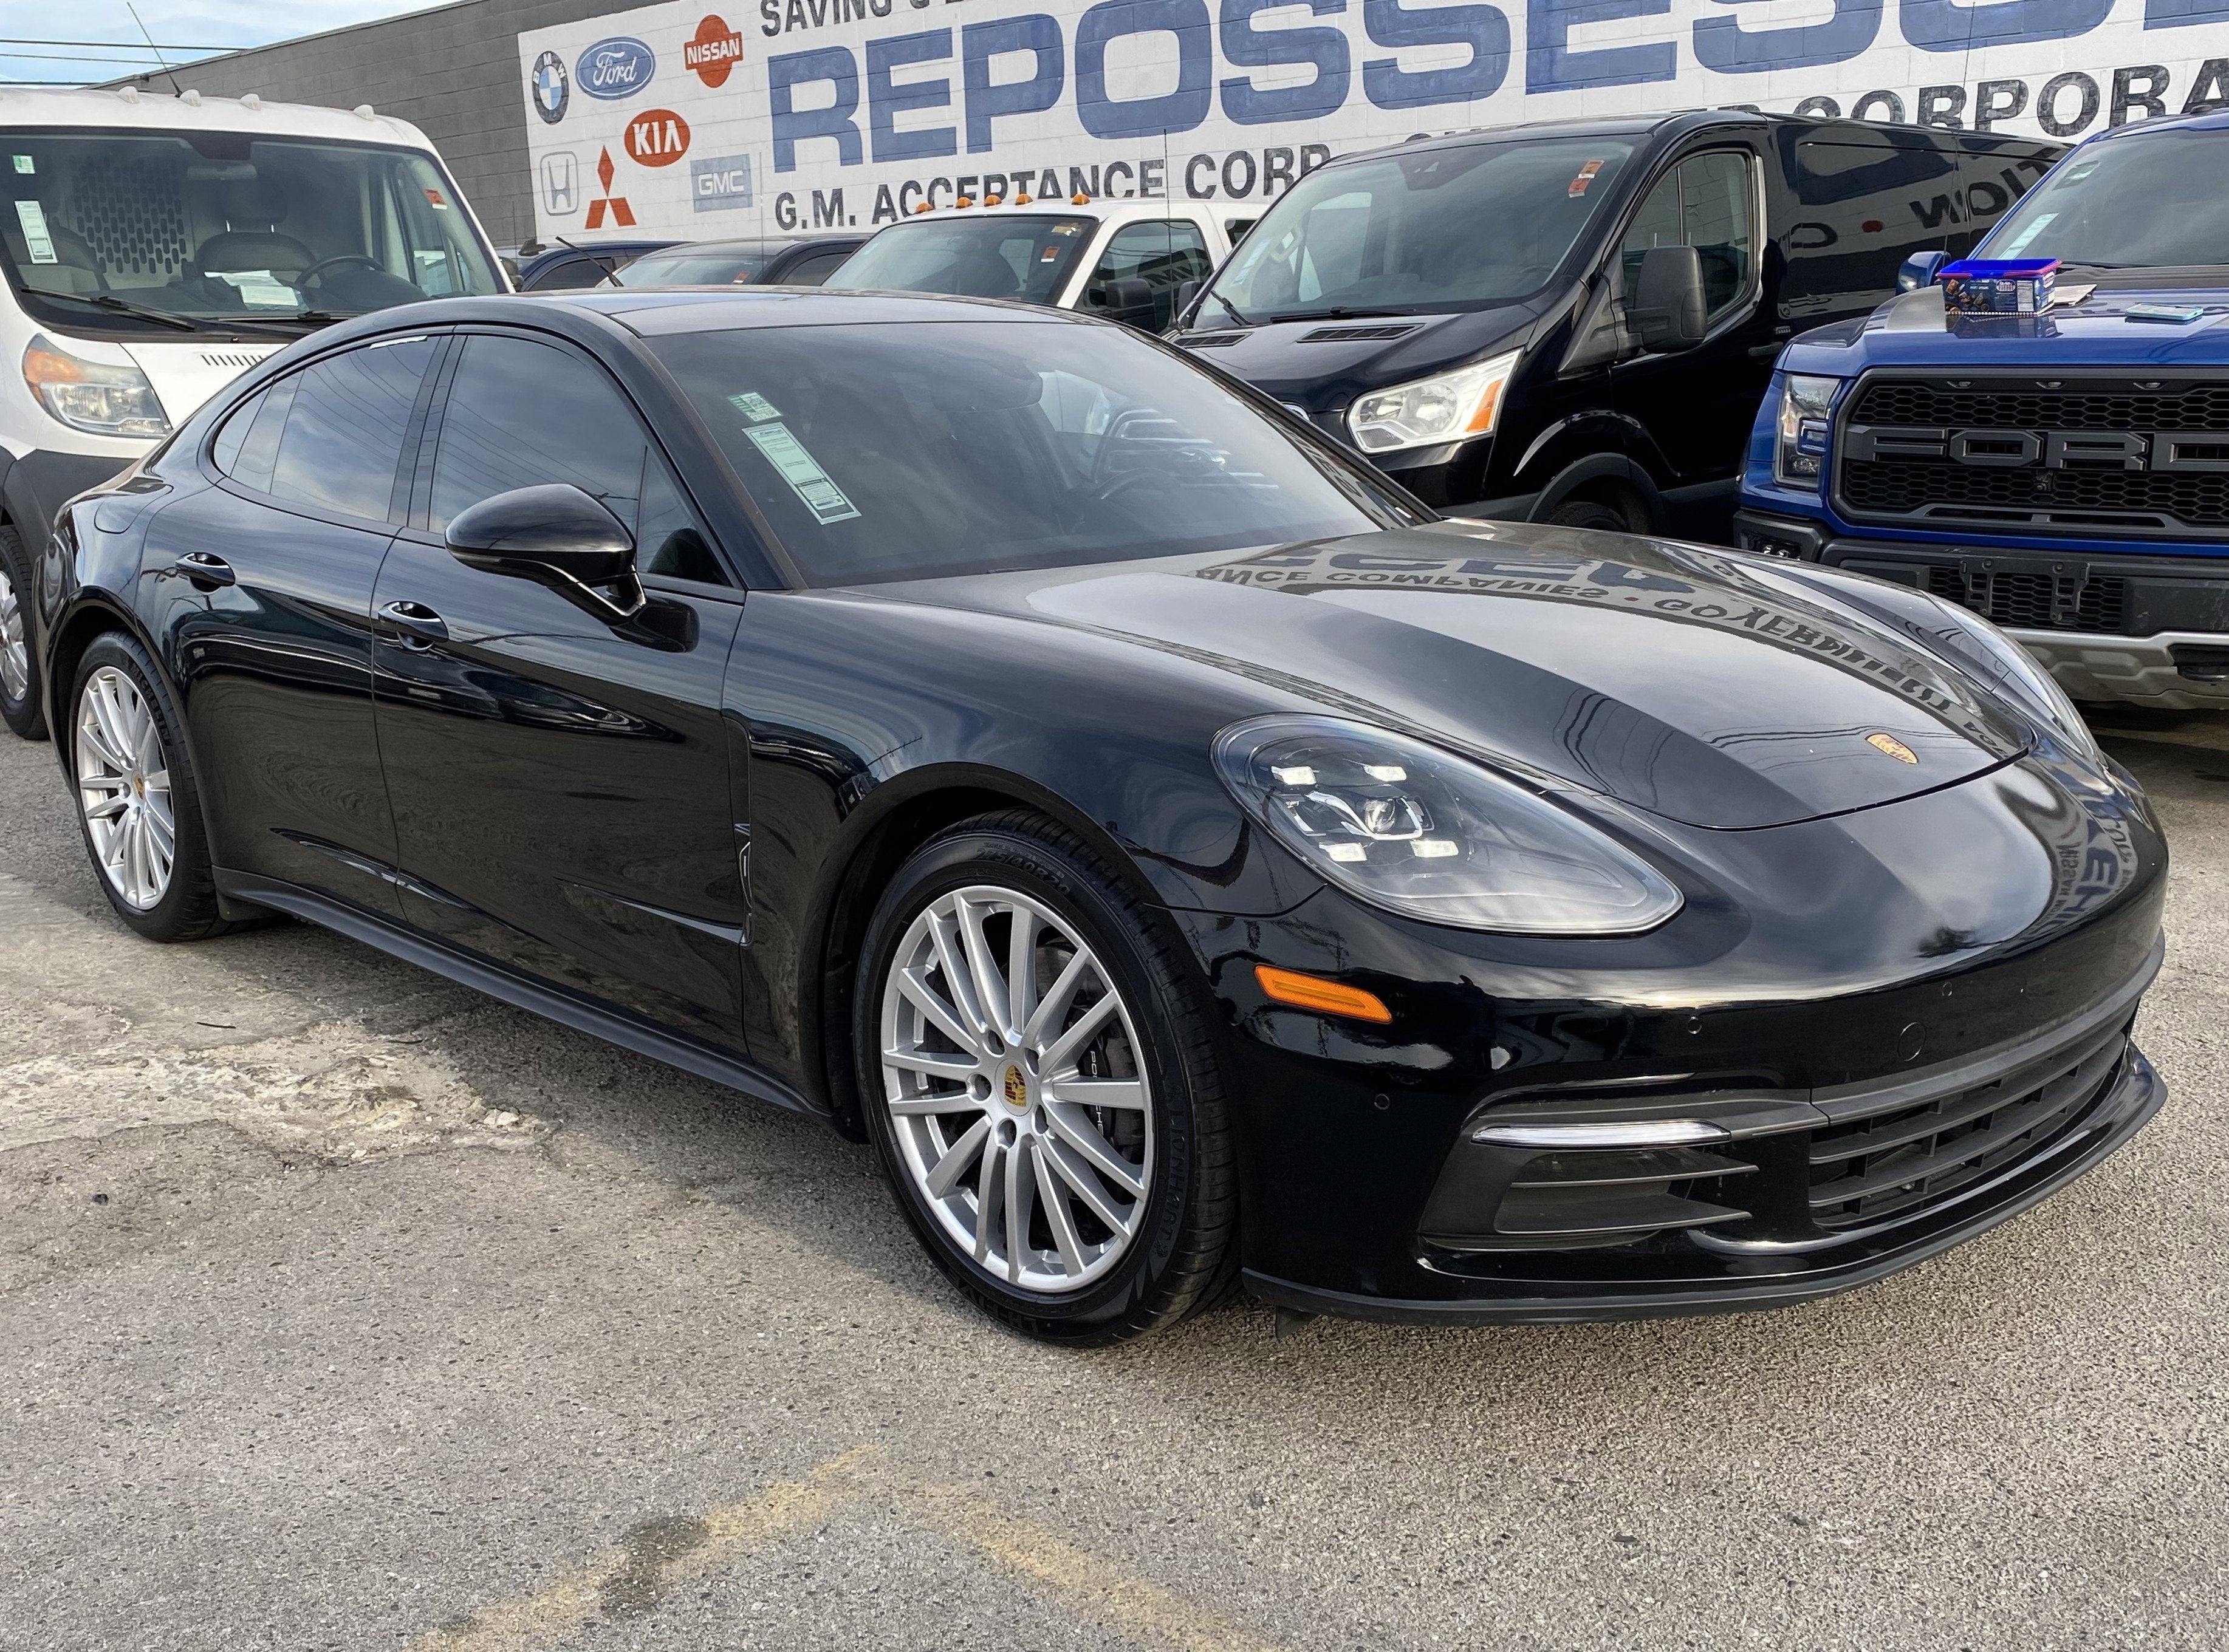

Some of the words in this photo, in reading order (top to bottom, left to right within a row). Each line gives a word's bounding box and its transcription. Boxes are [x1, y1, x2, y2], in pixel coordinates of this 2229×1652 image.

[533, 51, 566, 84] BMW
[592, 50, 637, 86] Ford
[687, 38, 741, 64] NISSAN
[632, 120, 682, 155] KIA
[698, 170, 745, 196] GMC
[775, 188, 855, 230] G.M.
